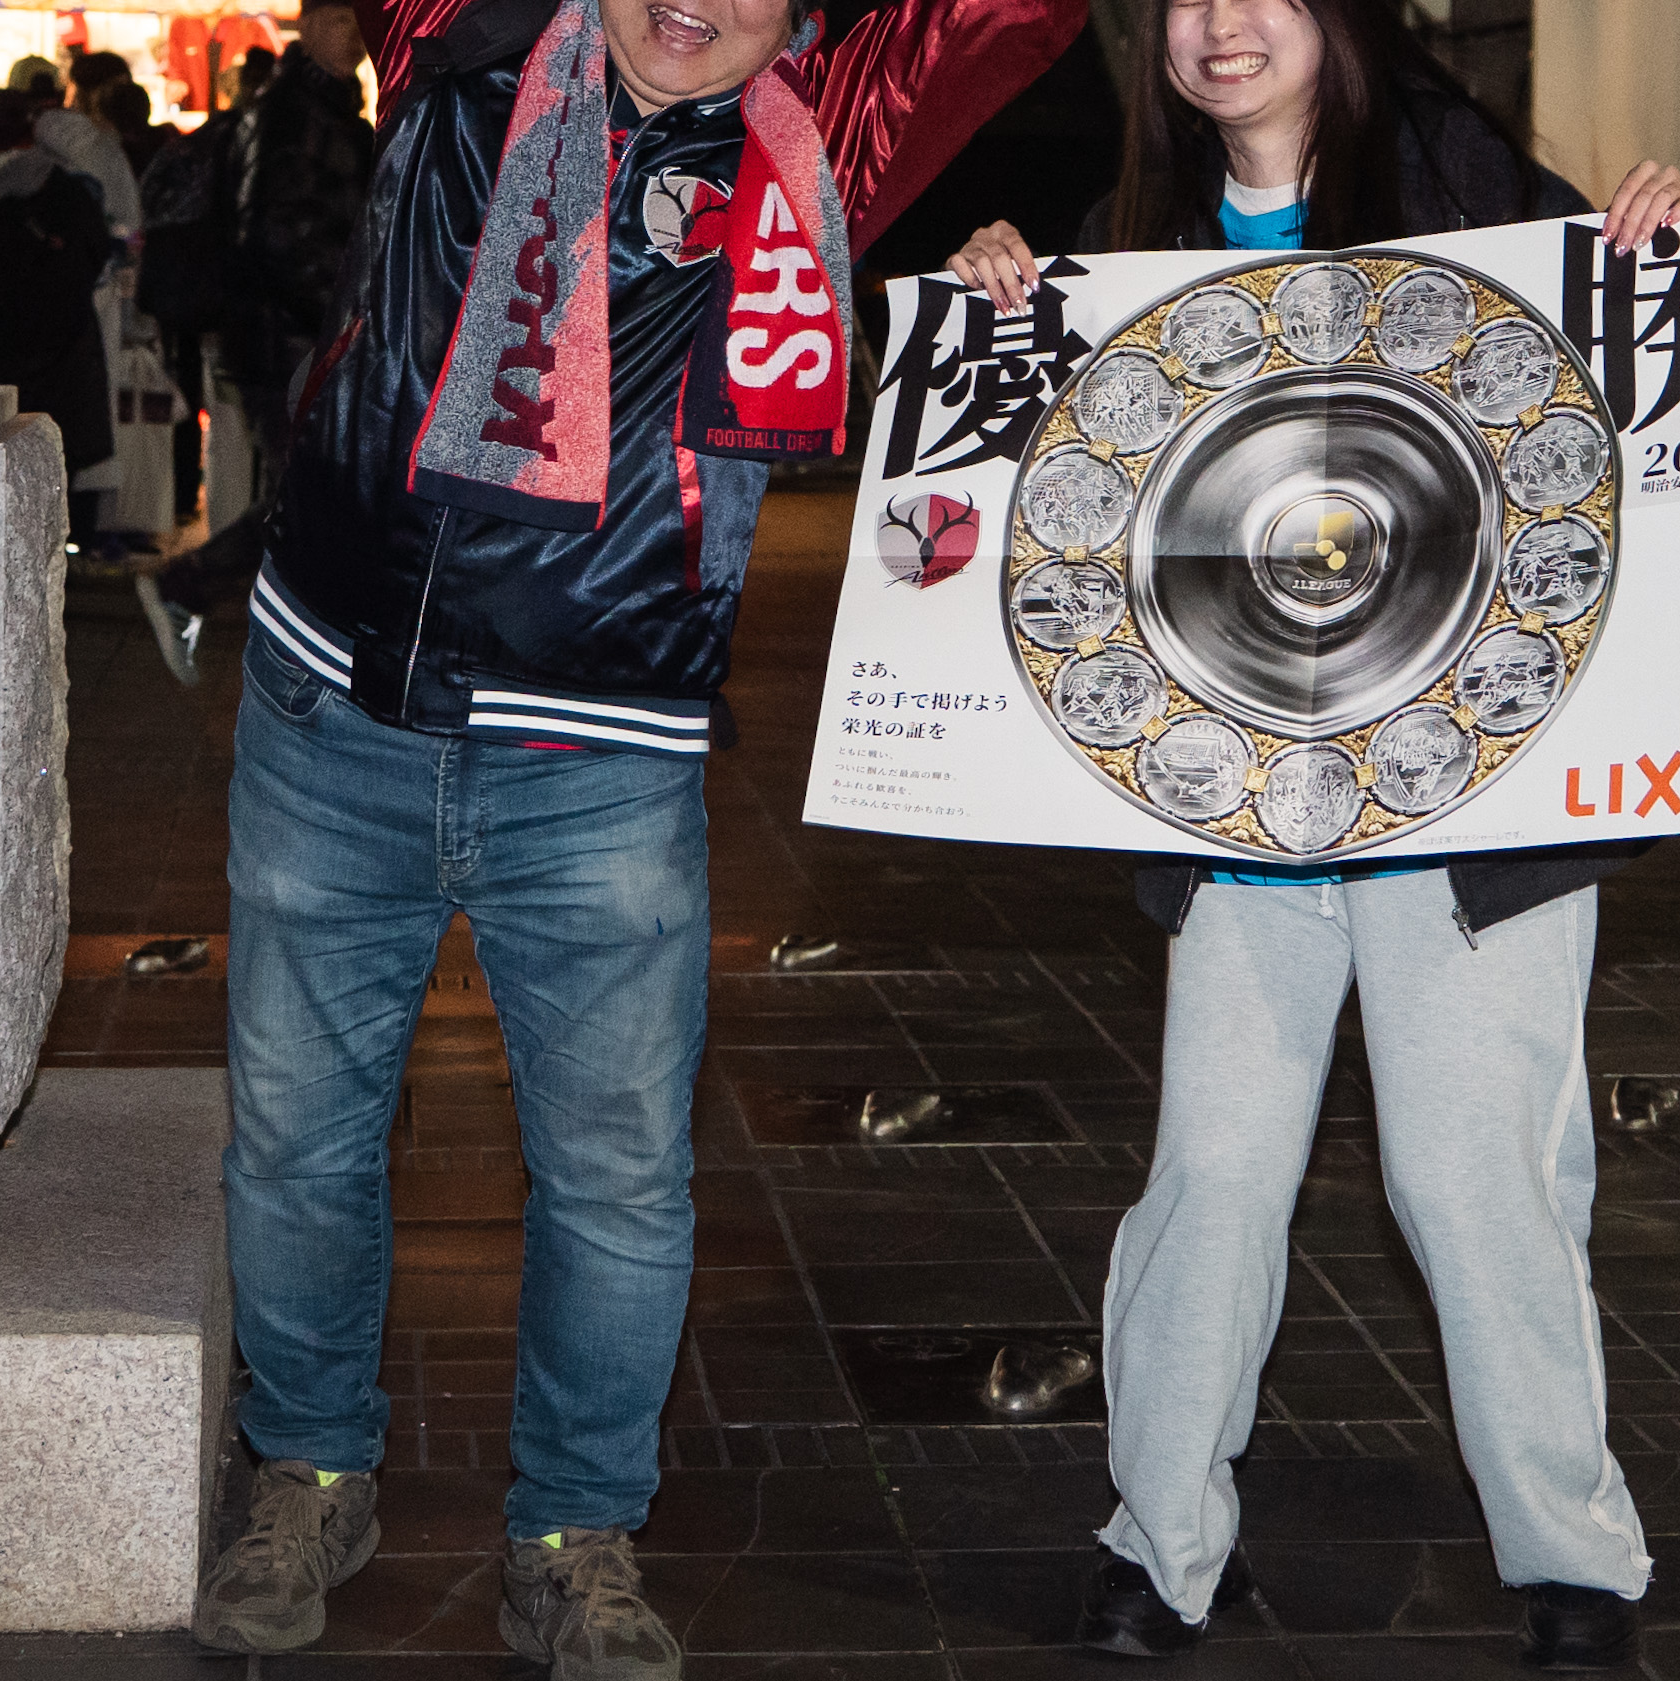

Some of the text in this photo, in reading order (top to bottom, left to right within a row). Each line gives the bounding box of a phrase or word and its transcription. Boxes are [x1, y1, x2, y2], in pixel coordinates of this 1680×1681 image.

[705, 427, 782, 451] FOOTBALL
[851, 660, 898, 680] さあ、
[846, 689, 1008, 712] その手で掲げよう
[841, 717, 947, 740] 栄光の証を
